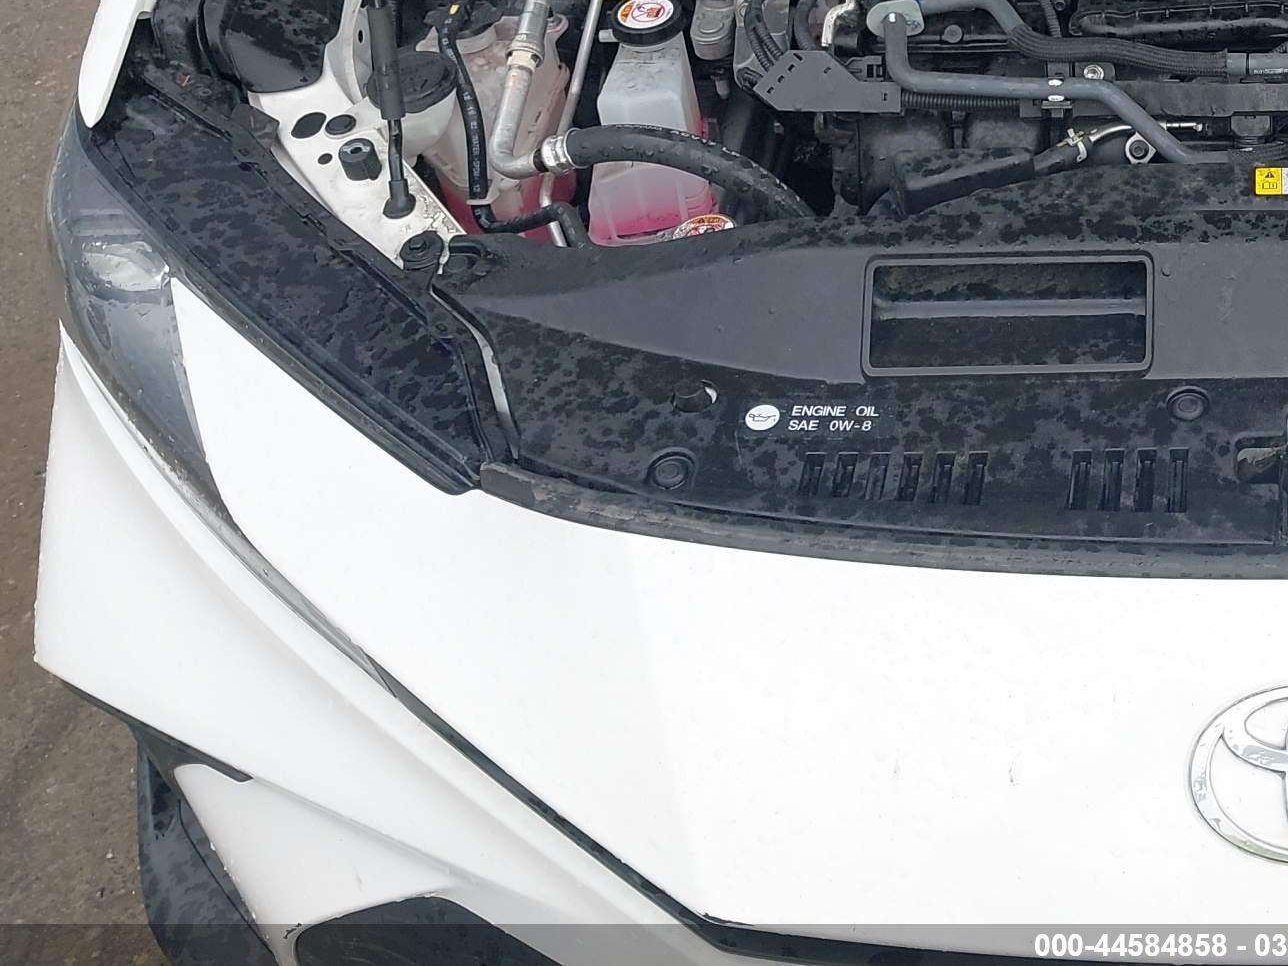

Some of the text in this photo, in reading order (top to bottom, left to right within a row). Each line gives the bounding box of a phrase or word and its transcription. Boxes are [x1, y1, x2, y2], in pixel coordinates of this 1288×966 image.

[791, 405, 879, 417] ENGINE OIL
[787, 419, 872, 432] SAE 0W-8
